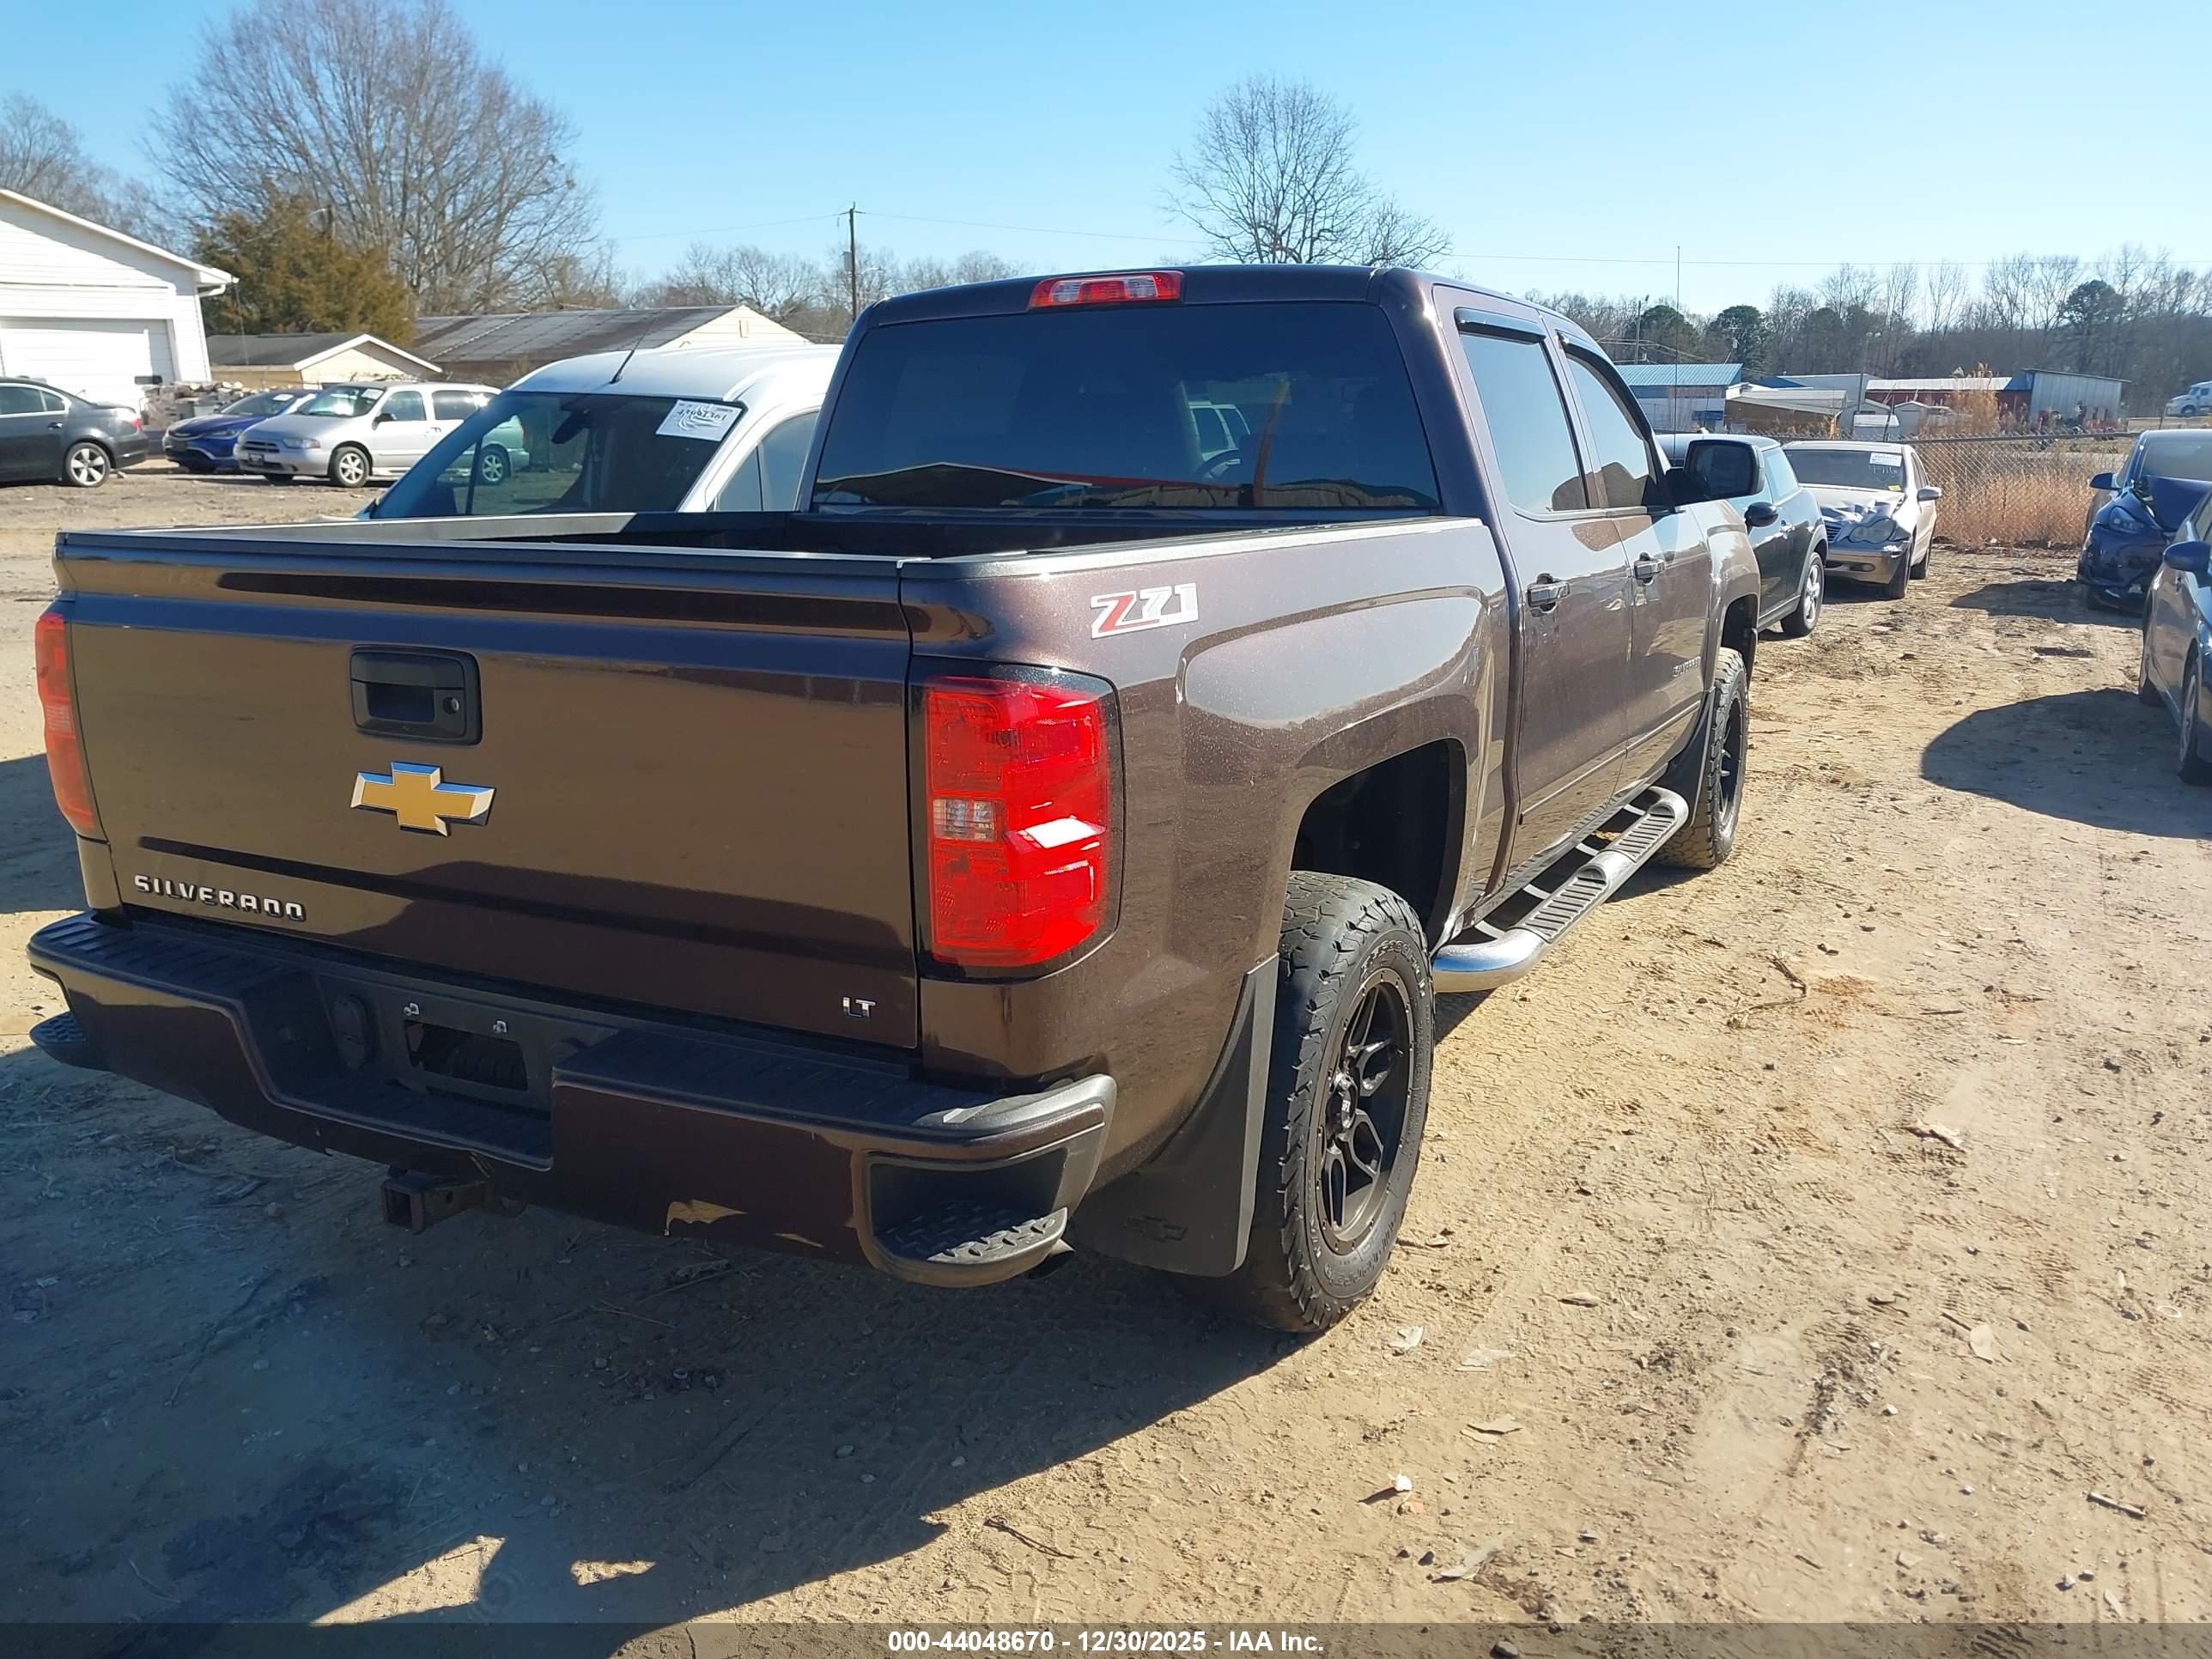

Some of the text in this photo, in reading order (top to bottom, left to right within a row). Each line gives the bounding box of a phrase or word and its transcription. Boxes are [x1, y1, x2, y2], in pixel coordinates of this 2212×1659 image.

[1090, 582, 1199, 639] Z71
[134, 874, 307, 921] SILVERADO
[842, 996, 876, 1018] LT
